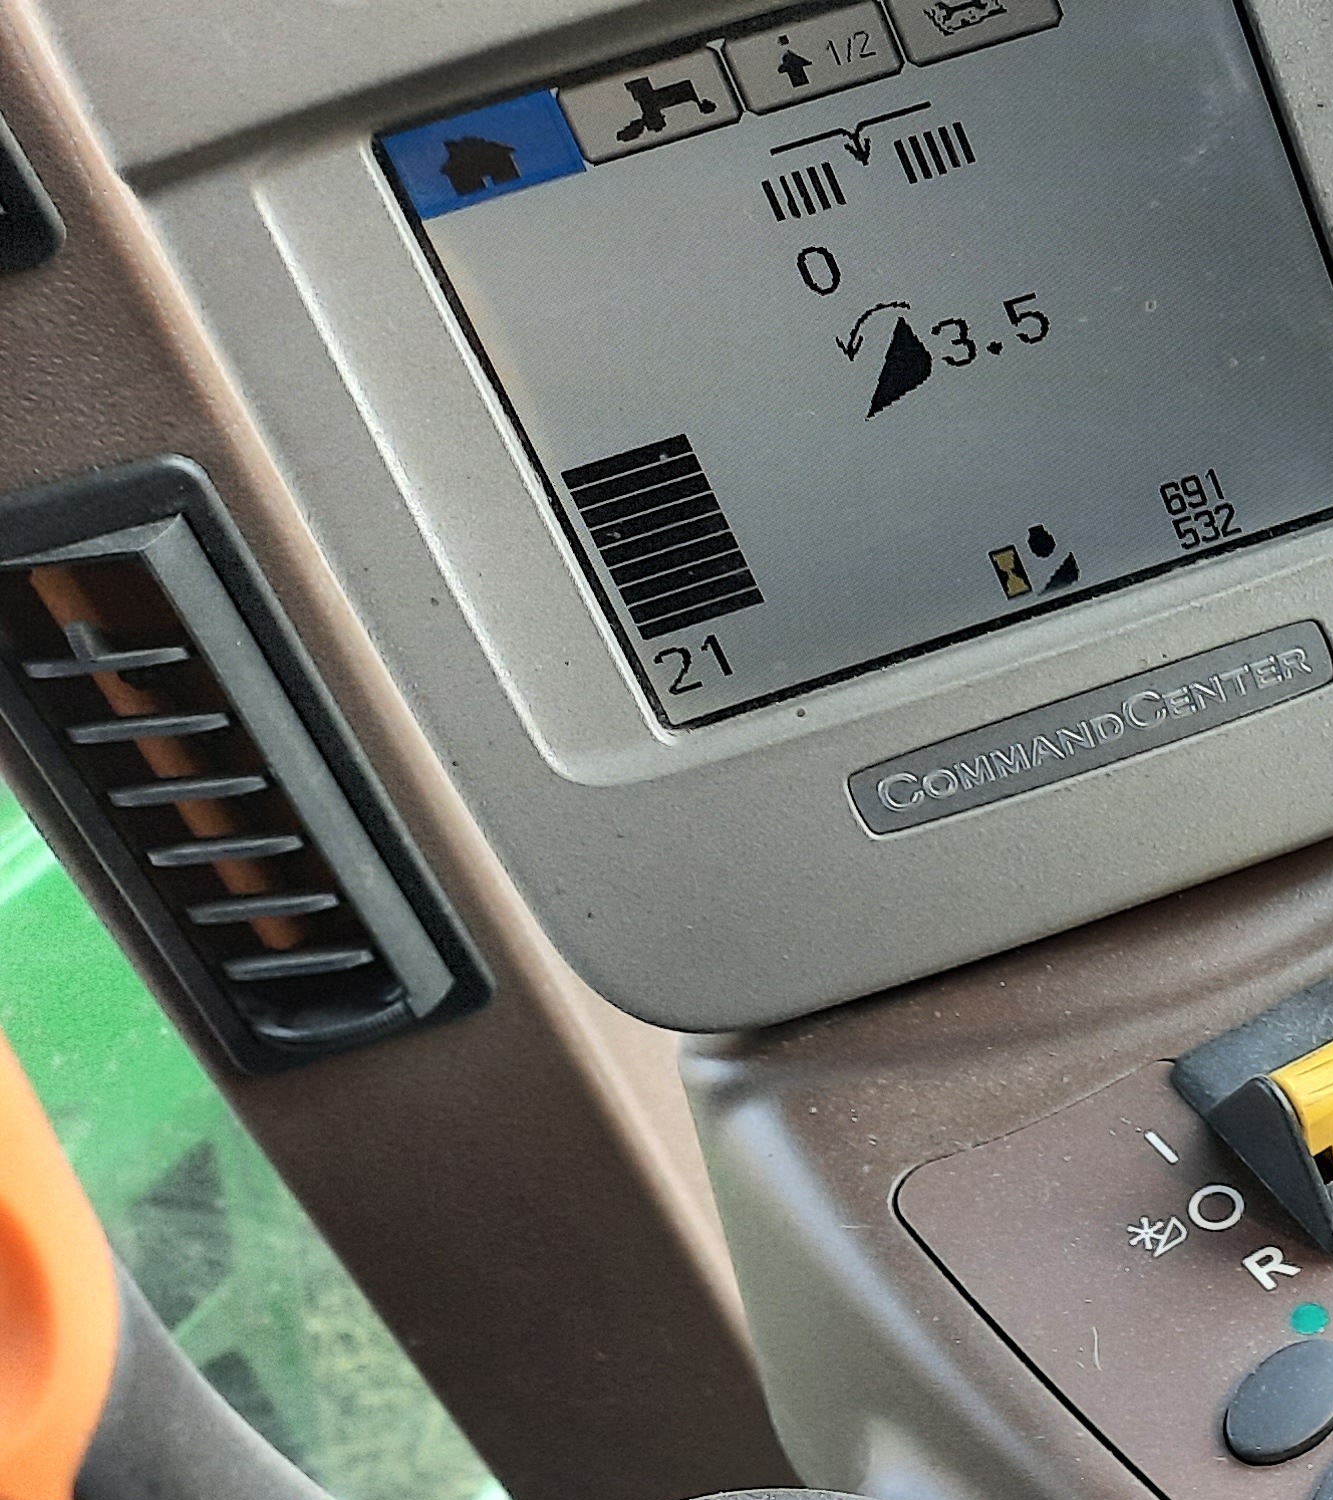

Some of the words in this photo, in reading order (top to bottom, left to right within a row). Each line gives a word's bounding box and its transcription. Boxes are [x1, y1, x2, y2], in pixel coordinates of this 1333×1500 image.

[826, 30, 877, 66] 1/2
[797, 246, 841, 297] 0
[930, 292, 1050, 368] 3.5
[1159, 468, 1225, 516] 691
[1171, 502, 1243, 550] 532
[653, 633, 734, 696] 21
[1241, 1245, 1303, 1291] R
